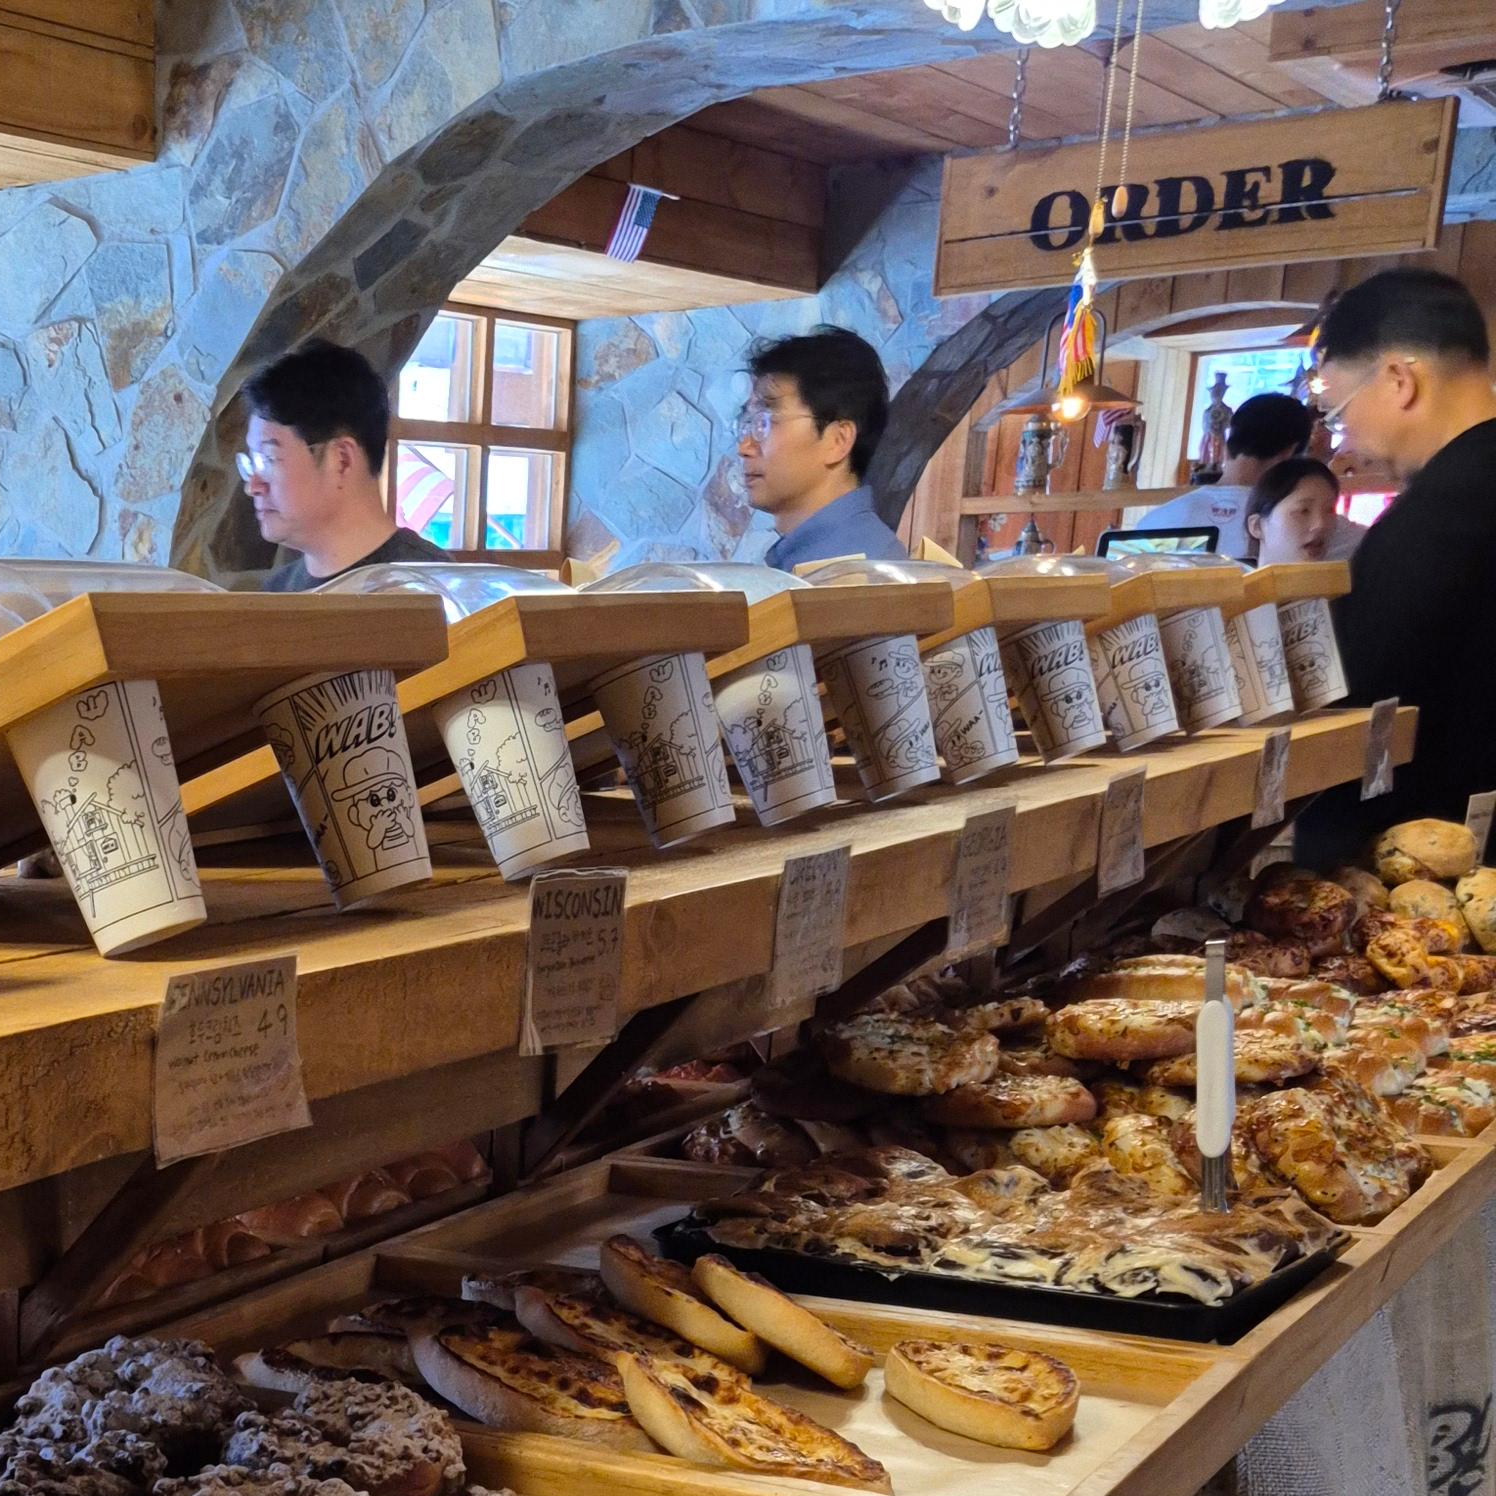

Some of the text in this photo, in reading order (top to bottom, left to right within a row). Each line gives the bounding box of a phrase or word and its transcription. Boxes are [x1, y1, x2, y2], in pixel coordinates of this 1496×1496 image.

[1030, 157, 1337, 252] ORDER
[1031, 640, 1083, 680] WAB!
[315, 702, 398, 764] WAB!
[532, 882, 623, 920] WISCONSIN
